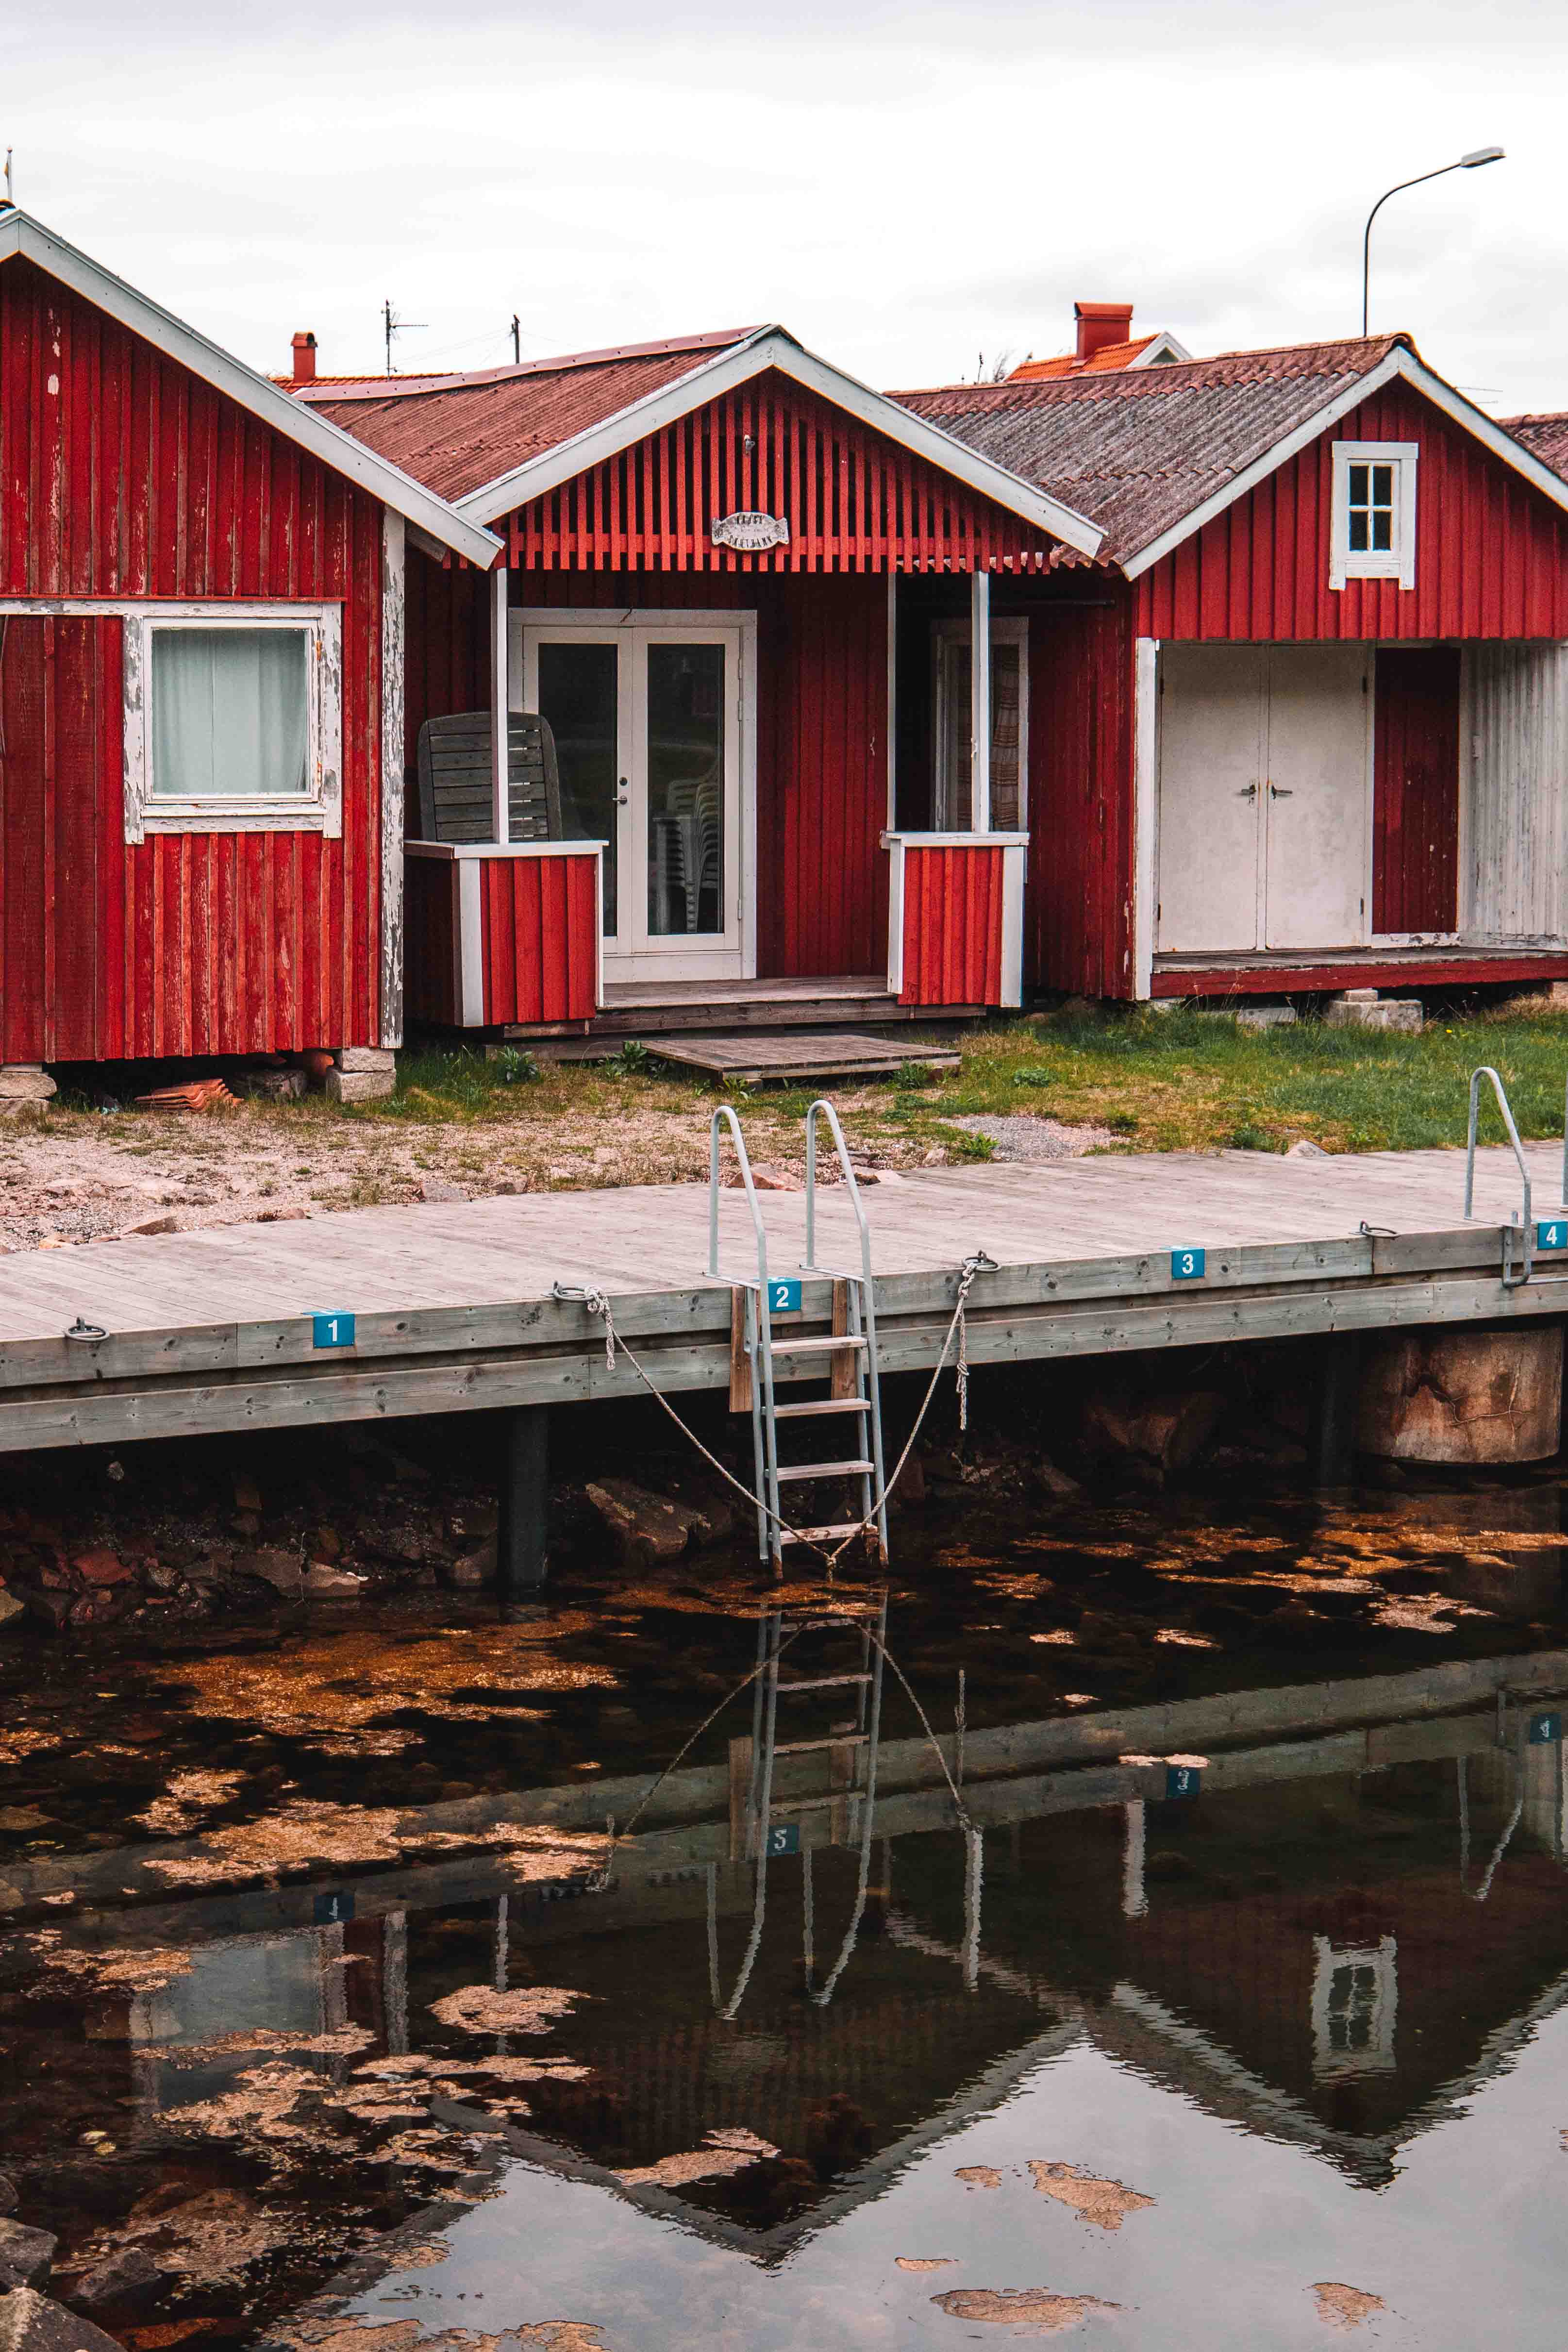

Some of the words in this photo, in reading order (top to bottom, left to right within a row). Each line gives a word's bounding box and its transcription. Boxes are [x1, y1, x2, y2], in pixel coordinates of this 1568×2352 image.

[1546, 1225, 1558, 1245] 4
[1182, 1253, 1194, 1274] 3
[776, 1286, 789, 1307] 2
[328, 1319, 338, 1342] 1
